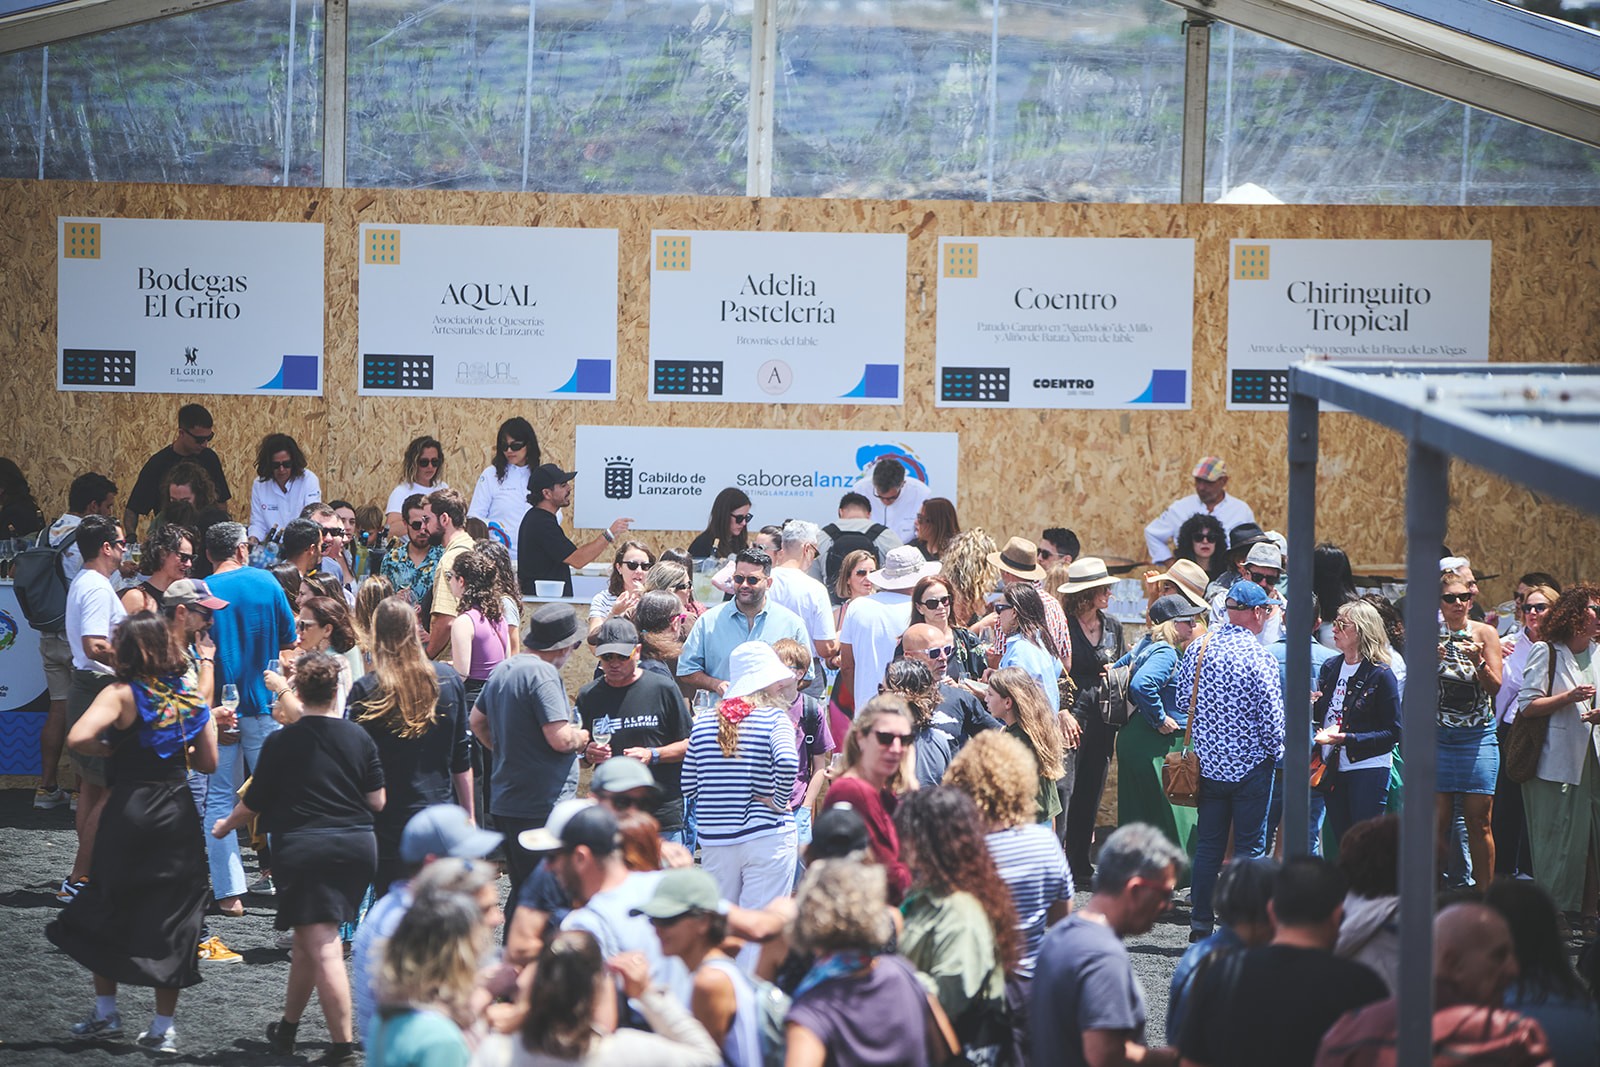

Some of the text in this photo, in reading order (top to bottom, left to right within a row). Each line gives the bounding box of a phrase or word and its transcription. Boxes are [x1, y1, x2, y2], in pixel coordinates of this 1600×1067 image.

[138, 267, 248, 297] Bodegas
[740, 273, 816, 297] Adelia
[441, 283, 537, 311] AQUAL
[1014, 287, 1117, 310] Coentro
[1287, 281, 1431, 310] Chiringuito
[144, 294, 241, 320] El Grifo
[720, 300, 835, 324] Pastelería
[484, 316, 497, 326] de
[1306, 308, 1408, 336] Tropical
[486, 326, 499, 336] de
[500, 326, 545, 336] Lanzarote
[736, 335, 779, 346] Brownies
[170, 368, 214, 376] EL GRIFO
[768, 366, 782, 384] A
[1033, 379, 1094, 389] COENTRO
[639, 472, 706, 484] Cabildo de
[639, 484, 703, 496] Lanzarote
[624, 714, 659, 724] ALPHA
